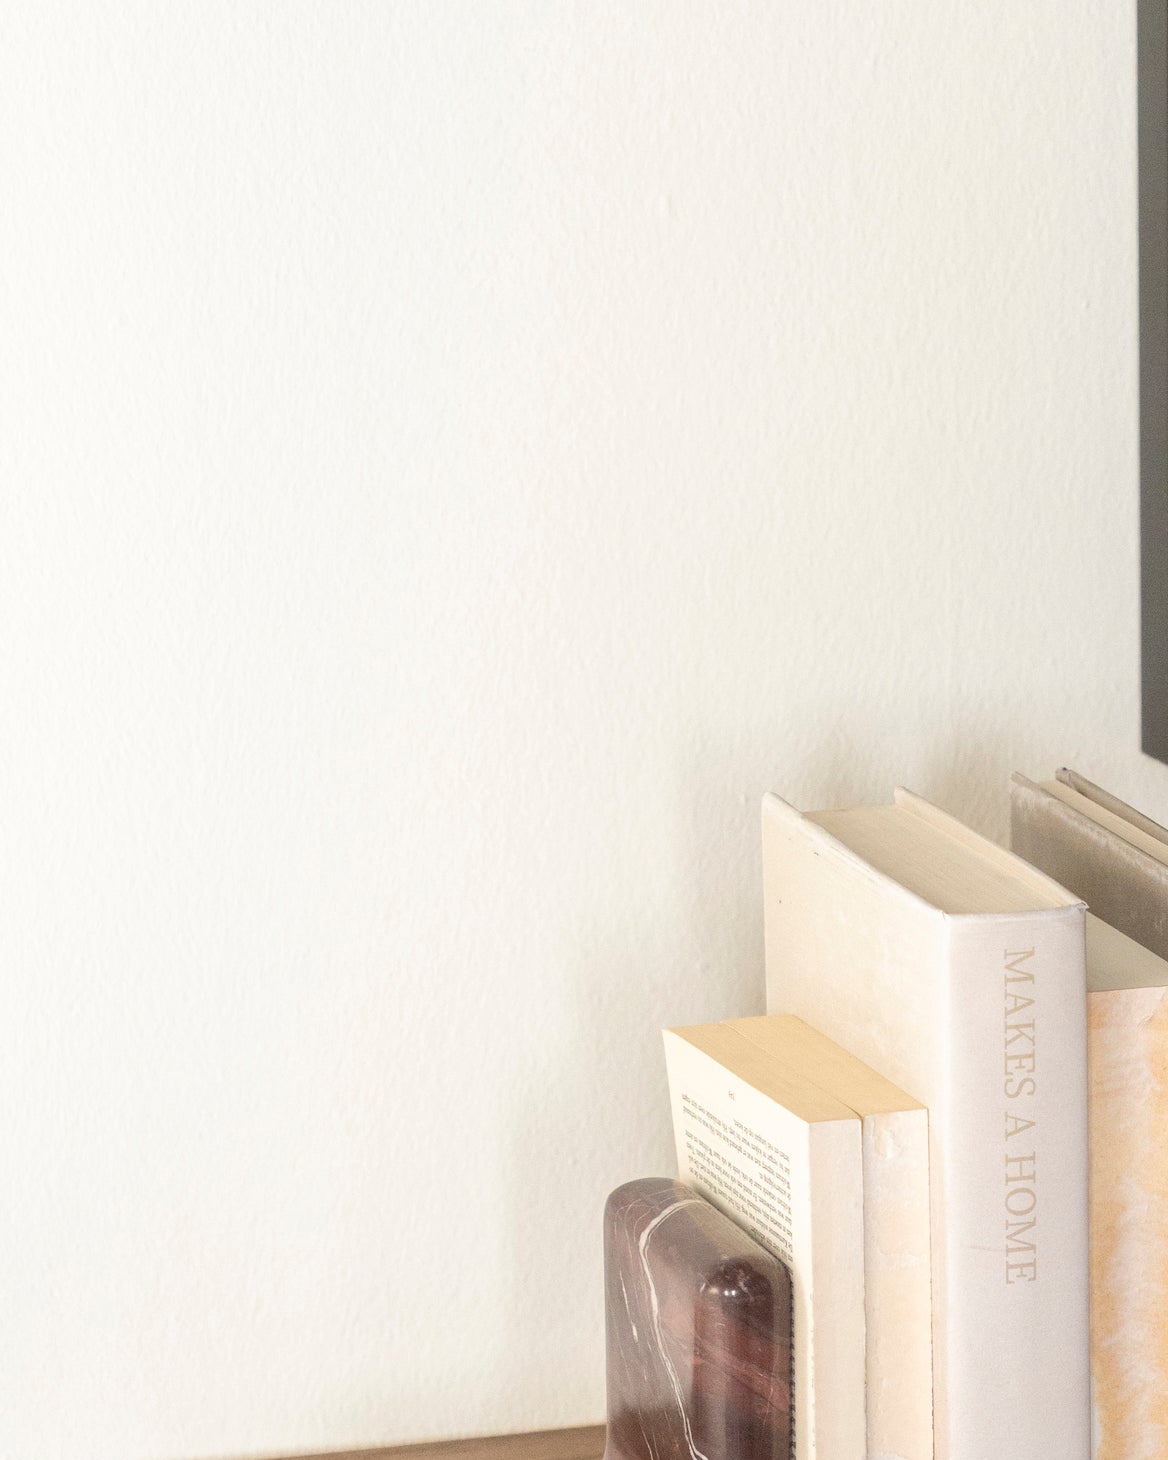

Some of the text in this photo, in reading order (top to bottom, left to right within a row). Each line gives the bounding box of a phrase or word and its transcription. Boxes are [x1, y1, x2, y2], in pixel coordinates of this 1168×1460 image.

[1003, 947, 1037, 1285] MAKES A HOME
